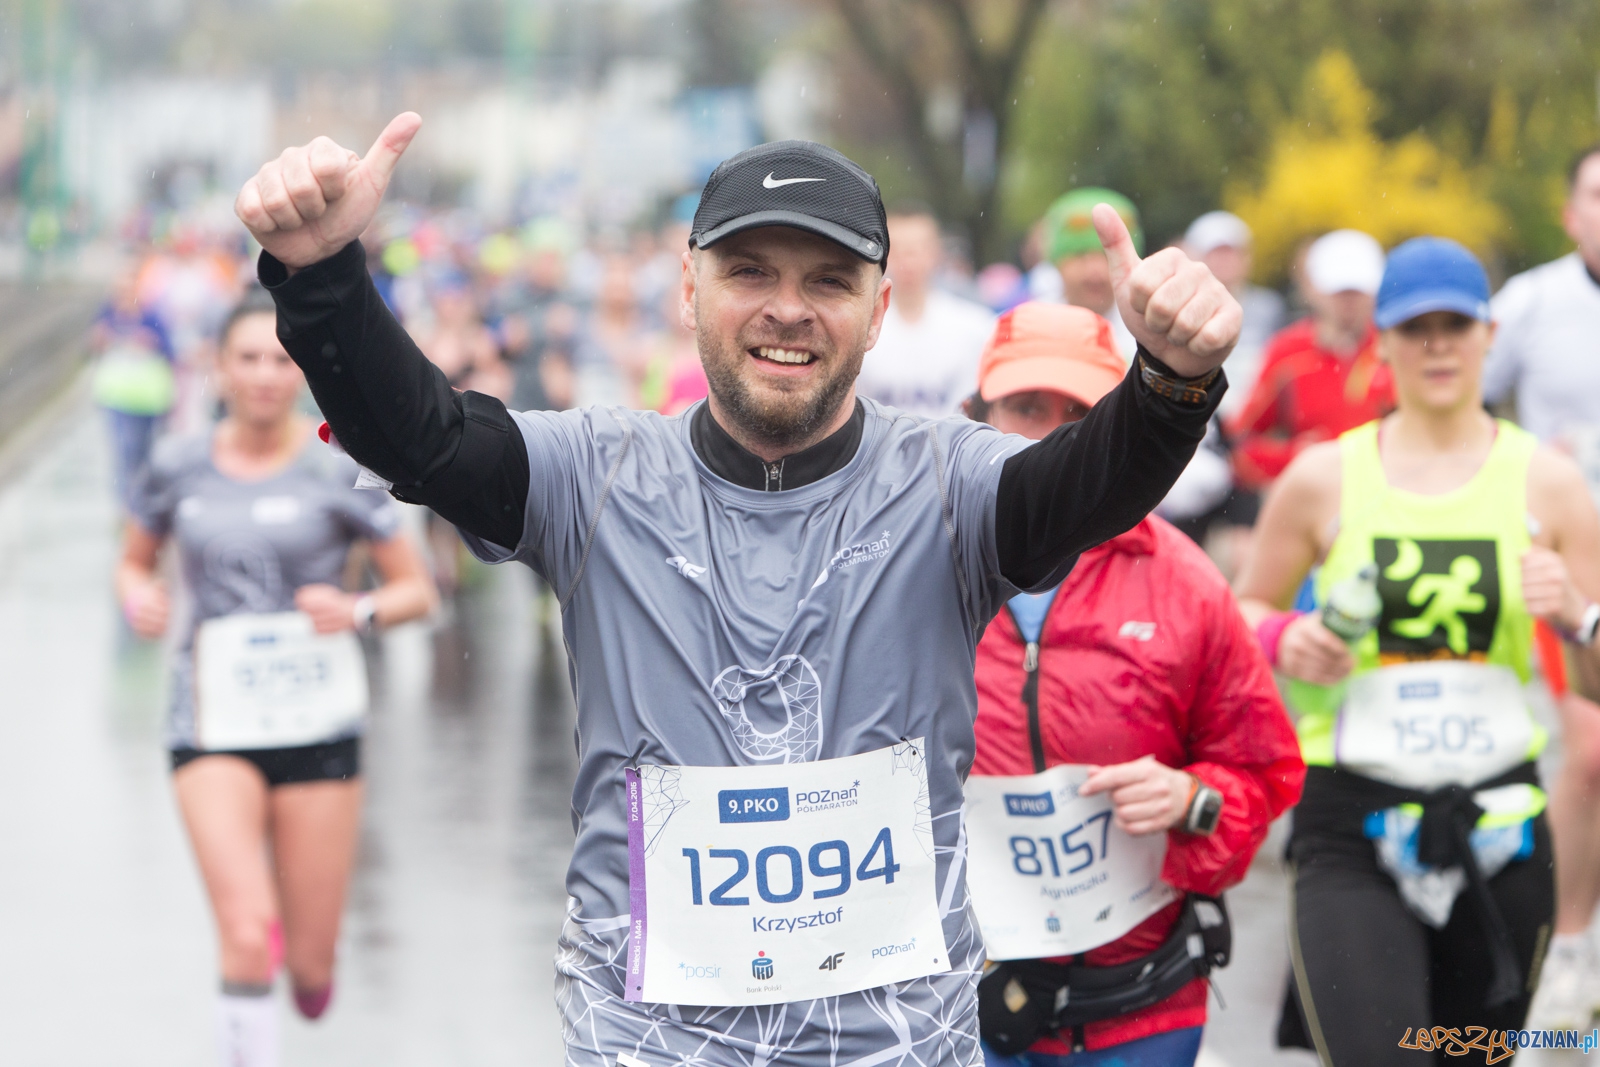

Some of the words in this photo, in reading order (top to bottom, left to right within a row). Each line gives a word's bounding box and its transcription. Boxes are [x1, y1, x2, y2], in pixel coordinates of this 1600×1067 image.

[1392, 714, 1496, 755] 1505
[797, 799, 858, 813] PÓŁMARATON
[1009, 809, 1113, 878] 8157
[682, 827, 900, 906] 12094
[1040, 871, 1109, 899] Agnieszka
[634, 919, 642, 939] M44
[752, 907, 844, 933] Krzysztof
[764, 984, 782, 992] Polski
